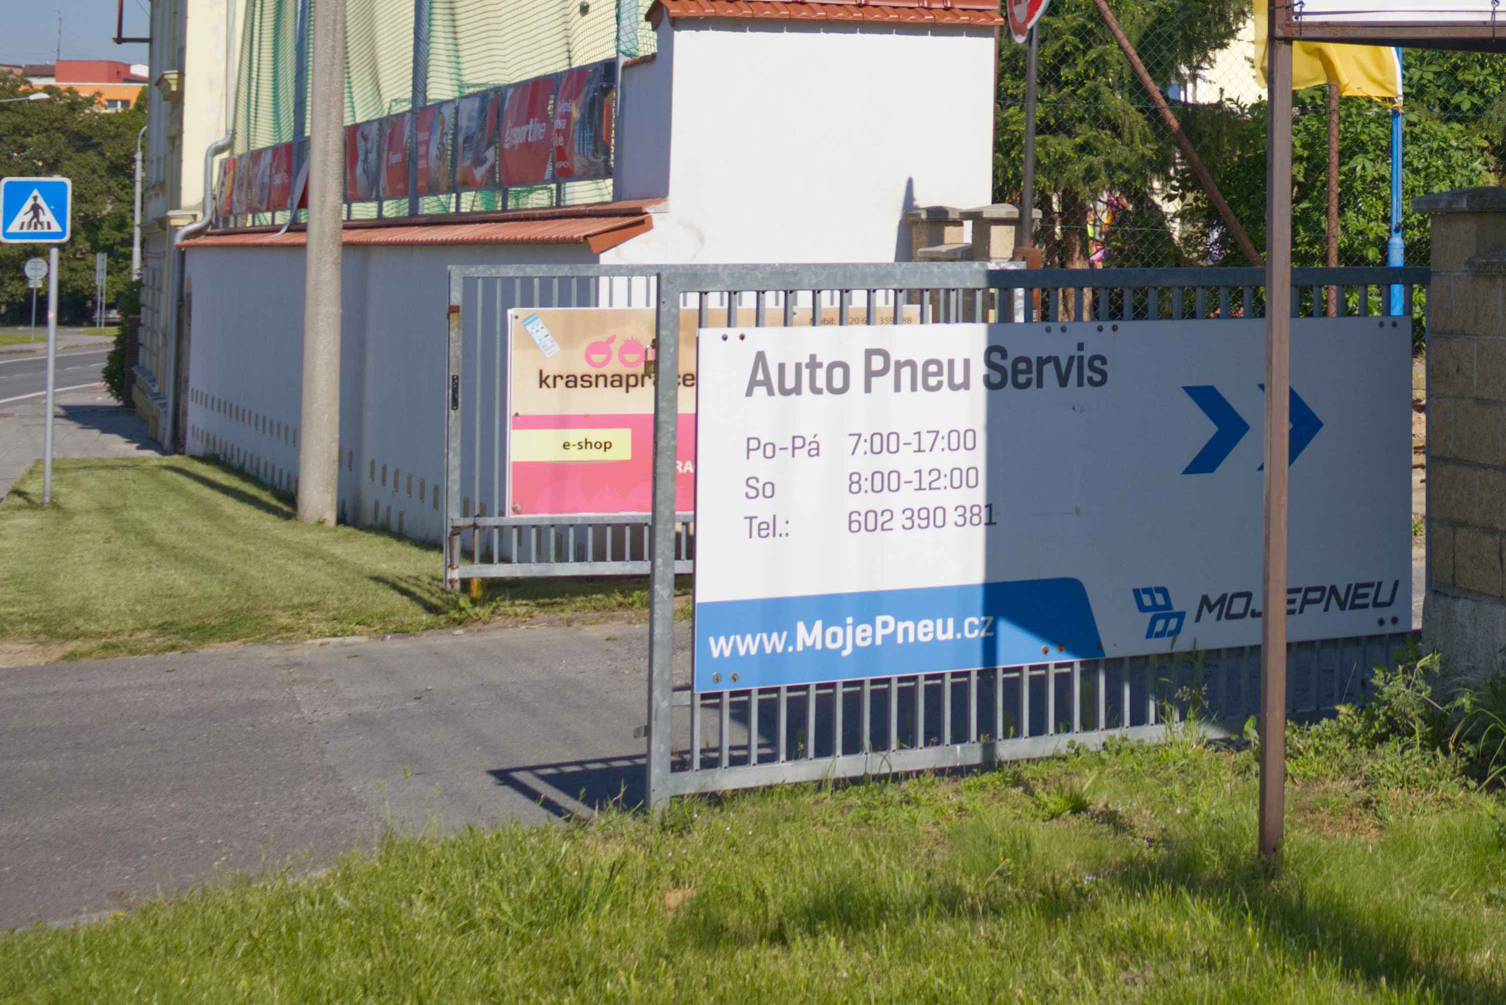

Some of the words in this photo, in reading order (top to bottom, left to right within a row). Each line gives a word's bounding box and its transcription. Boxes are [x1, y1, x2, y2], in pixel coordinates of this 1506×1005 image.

[745, 350, 850, 397] Auto
[863, 348, 971, 394] Pneu
[982, 342, 1108, 391] Servis
[562, 438, 613, 452] e-shop
[745, 434, 821, 460] Po-Pá
[848, 428, 977, 456] 7:00-17:00
[745, 476, 775, 499] So
[848, 466, 979, 495] 8:00-12:00
[744, 514, 790, 539] Tel.:
[848, 509, 894, 533] 602
[901, 506, 947, 530] 390
[953, 503, 997, 528] 381
[708, 615, 995, 657] www.MojePneu.cz
